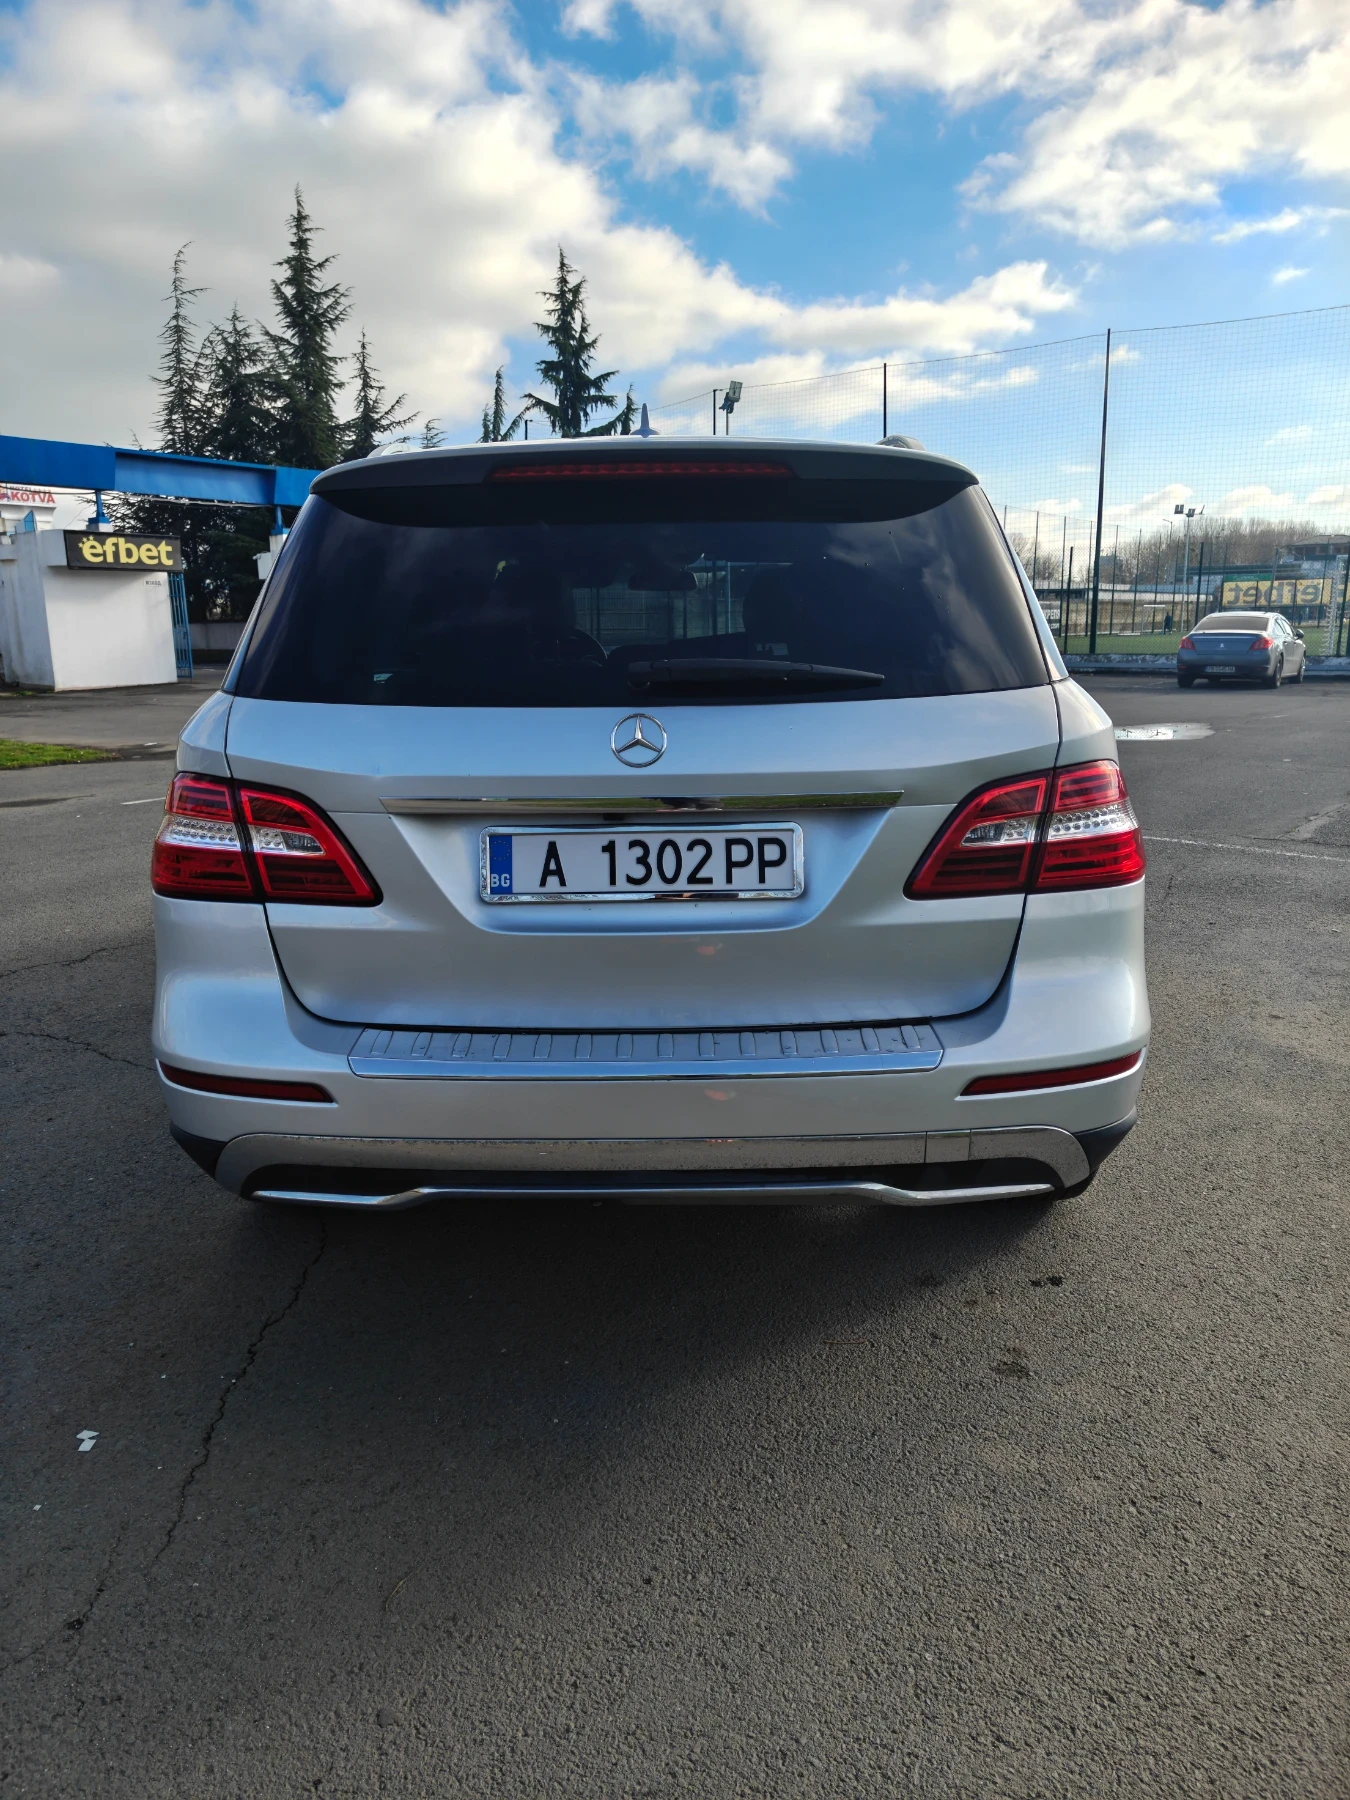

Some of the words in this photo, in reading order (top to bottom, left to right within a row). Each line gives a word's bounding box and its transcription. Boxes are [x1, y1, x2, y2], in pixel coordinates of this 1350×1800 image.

[11, 491, 55, 504] KOTVA
[82, 536, 173, 566] efbet
[539, 841, 567, 887] A
[490, 873, 511, 887] BG
